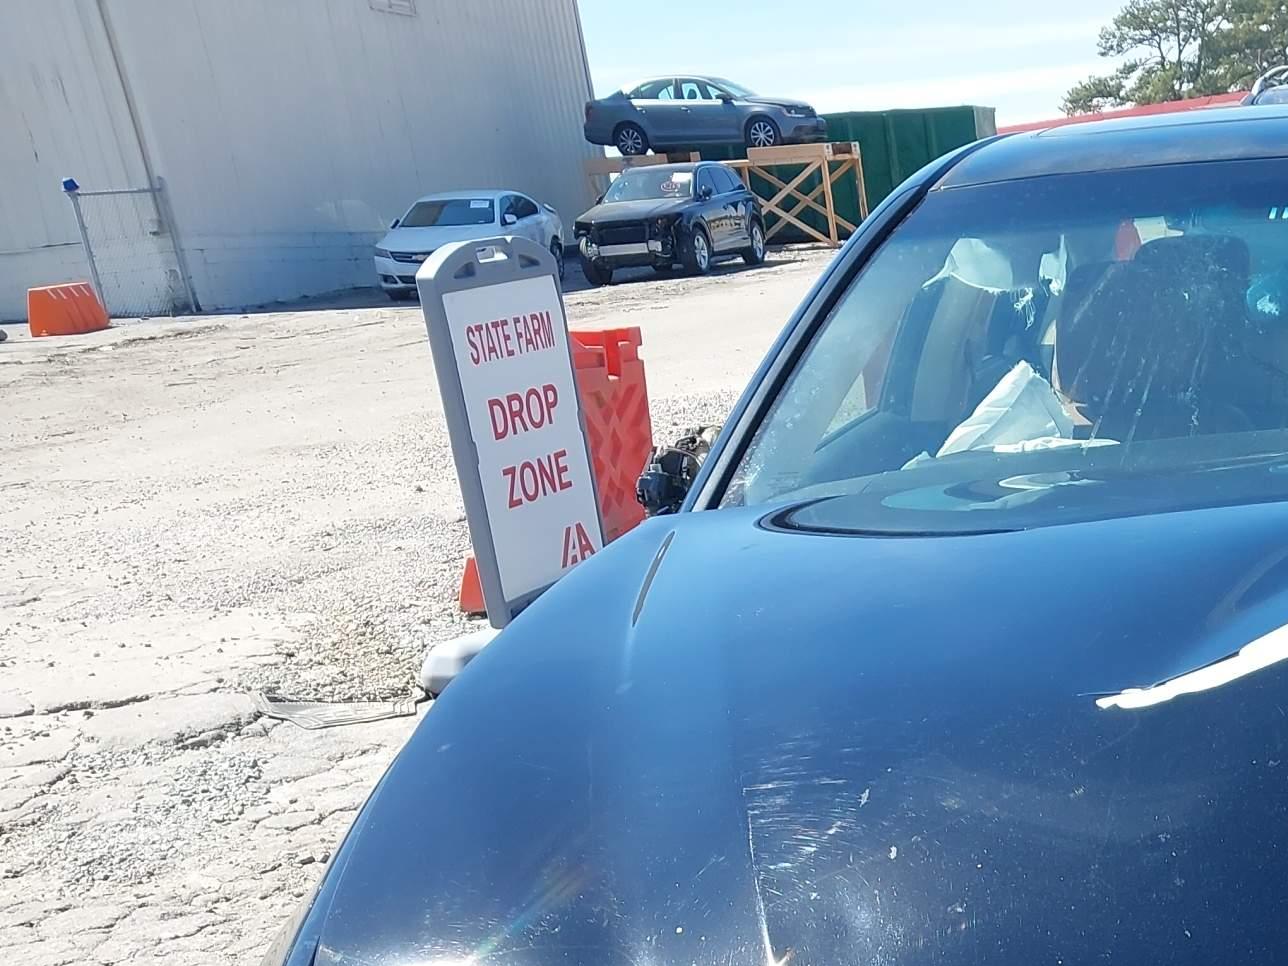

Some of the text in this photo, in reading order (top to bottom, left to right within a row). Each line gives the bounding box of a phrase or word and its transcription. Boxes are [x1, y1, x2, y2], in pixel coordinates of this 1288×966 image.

[465, 310, 556, 366] STATE FARM
[487, 383, 559, 441] DROP
[502, 448, 573, 509] ZONE
